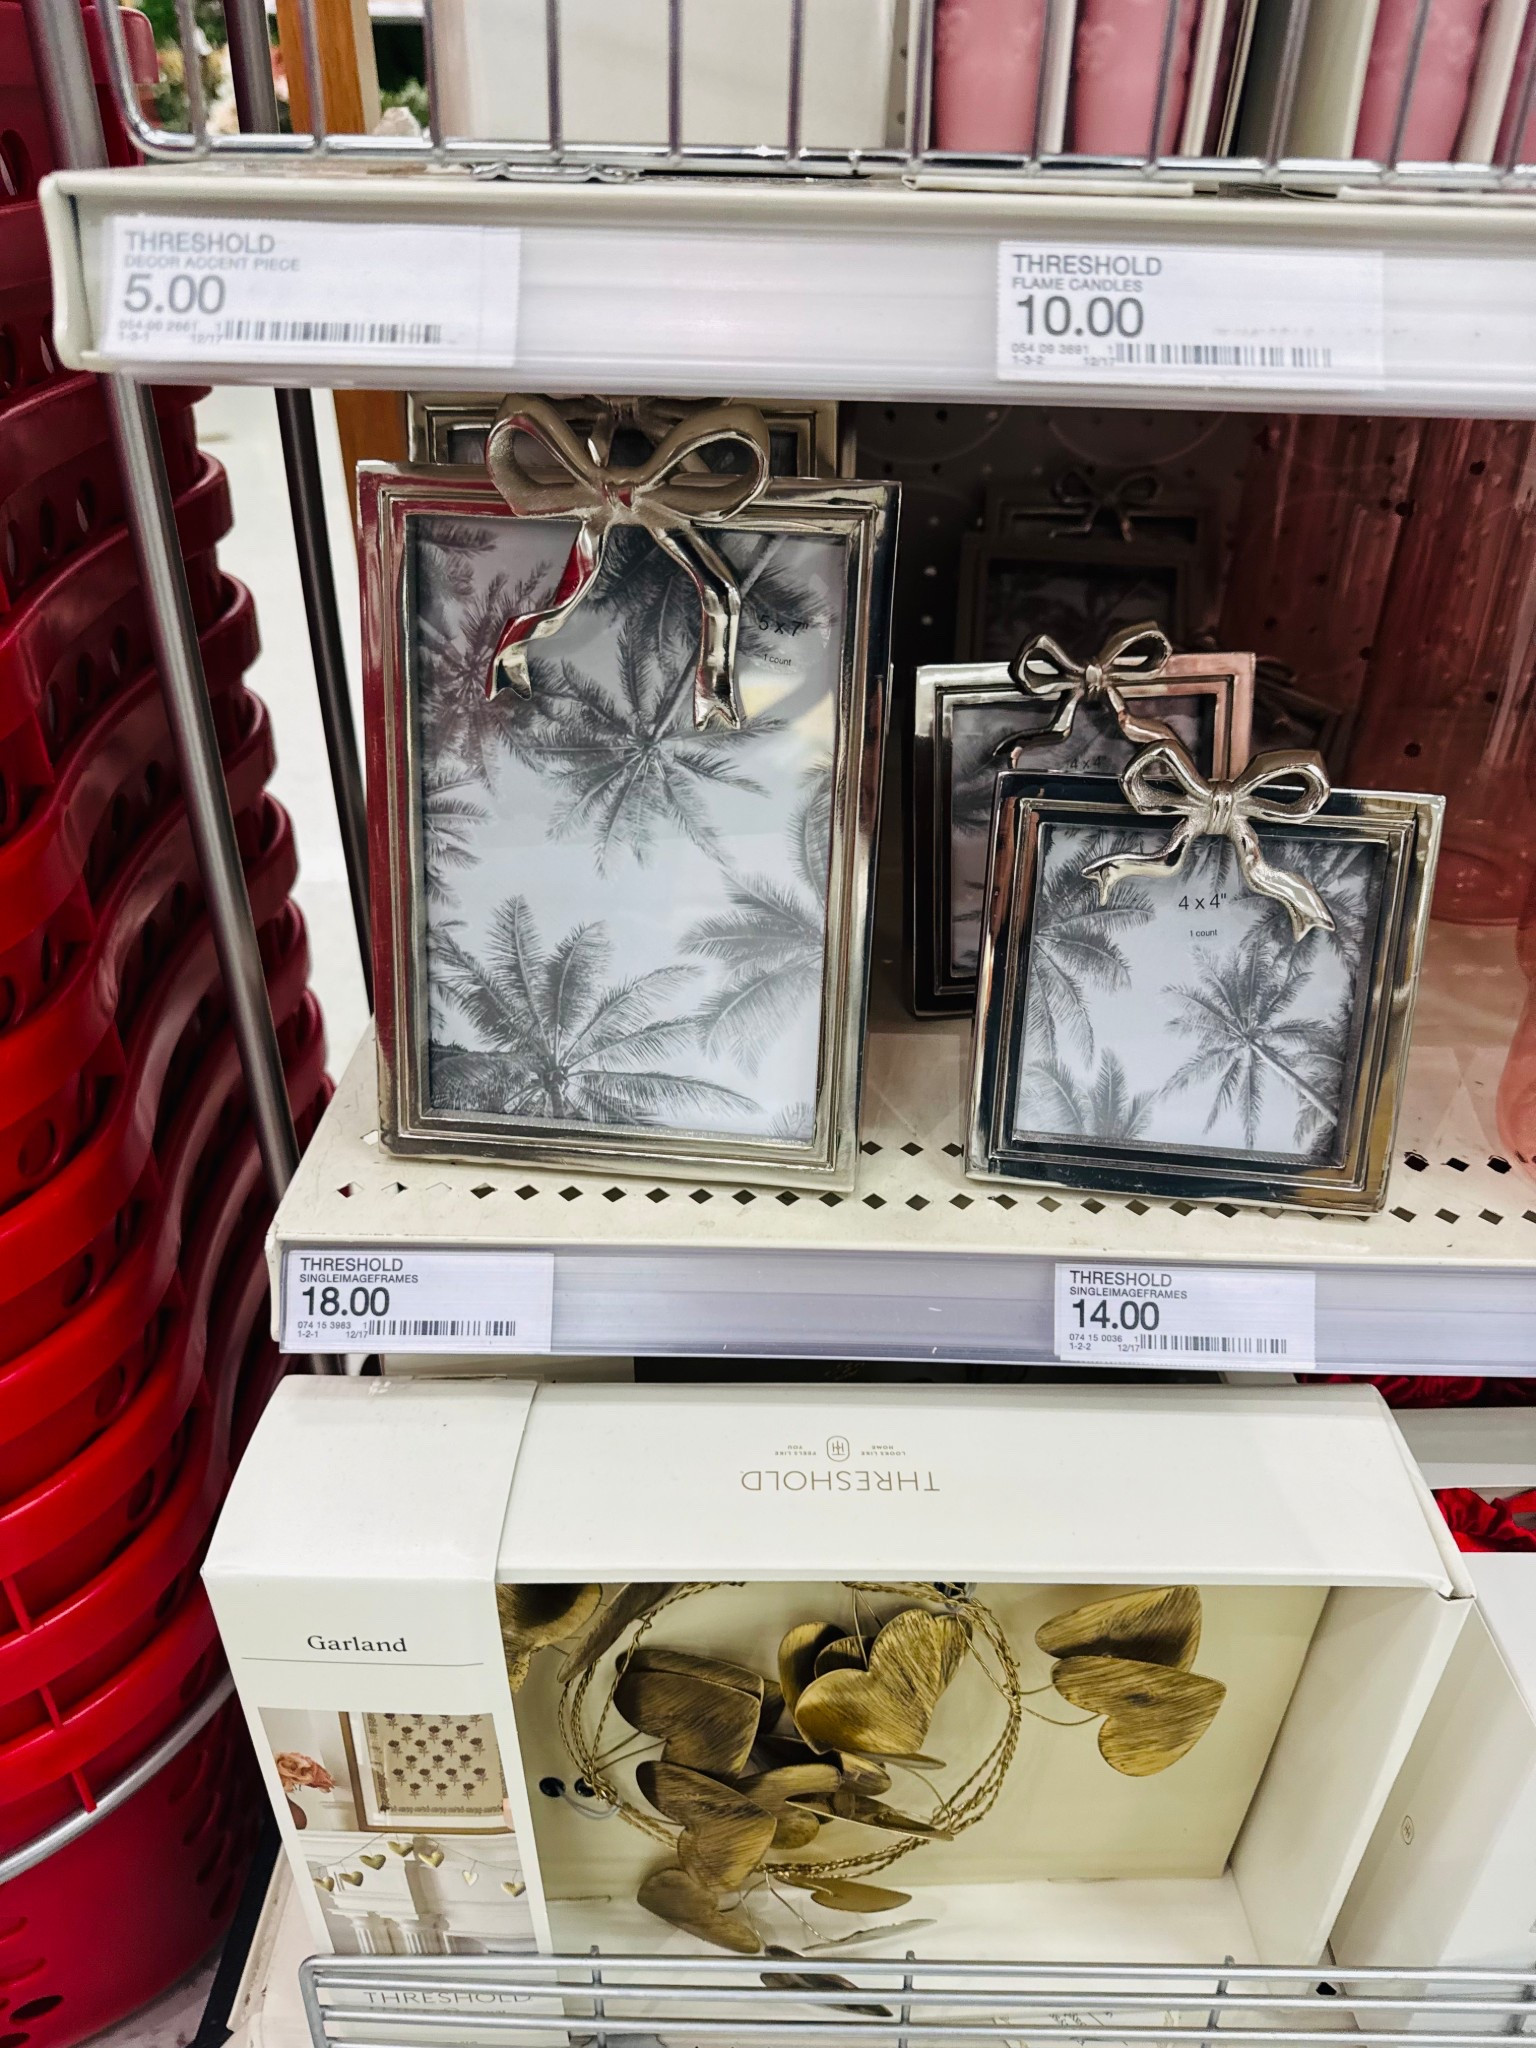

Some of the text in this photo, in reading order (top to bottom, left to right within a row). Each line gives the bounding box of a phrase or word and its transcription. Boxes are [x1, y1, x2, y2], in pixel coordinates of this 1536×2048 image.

[125, 231, 275, 254] THRESHOLD
[124, 255, 300, 271] DECOR ACCENT PIECE
[1013, 254, 1162, 277] THRESHOLD
[1013, 277, 1143, 292] FLAME CANDLES
[123, 273, 226, 315] 5.00
[1017, 294, 1144, 338] 10.00
[759, 615, 769, 631] 5
[774, 622, 784, 634] x
[769, 655, 792, 666] count
[1178, 893, 1227, 910] 4 x 4"
[1195, 929, 1218, 938] count
[300, 1257, 404, 1272] THRESHOLD
[299, 1273, 419, 1284] SINGLEIMAGEFRAMES
[1069, 1270, 1173, 1287] THRESHOLD
[1069, 1286, 1188, 1300] SINGLEIMAGEFRAMES
[302, 1286, 390, 1317] 18.00
[1072, 1299, 1160, 1331] 14.00
[297, 1321, 314, 1329] 074
[317, 1321, 327, 1330] 15
[329, 1321, 352, 1330] 3983
[346, 1331, 368, 1339] 12/17
[1069, 1333, 1085, 1341] 074
[1088, 1334, 1099, 1342] 15
[1101, 1335, 1123, 1343] 0036
[1069, 1342, 1140, 1353] 1-2-2 12/17
[741, 1470, 940, 1491] THRESHOLD
[307, 1635, 408, 1652] Garland
